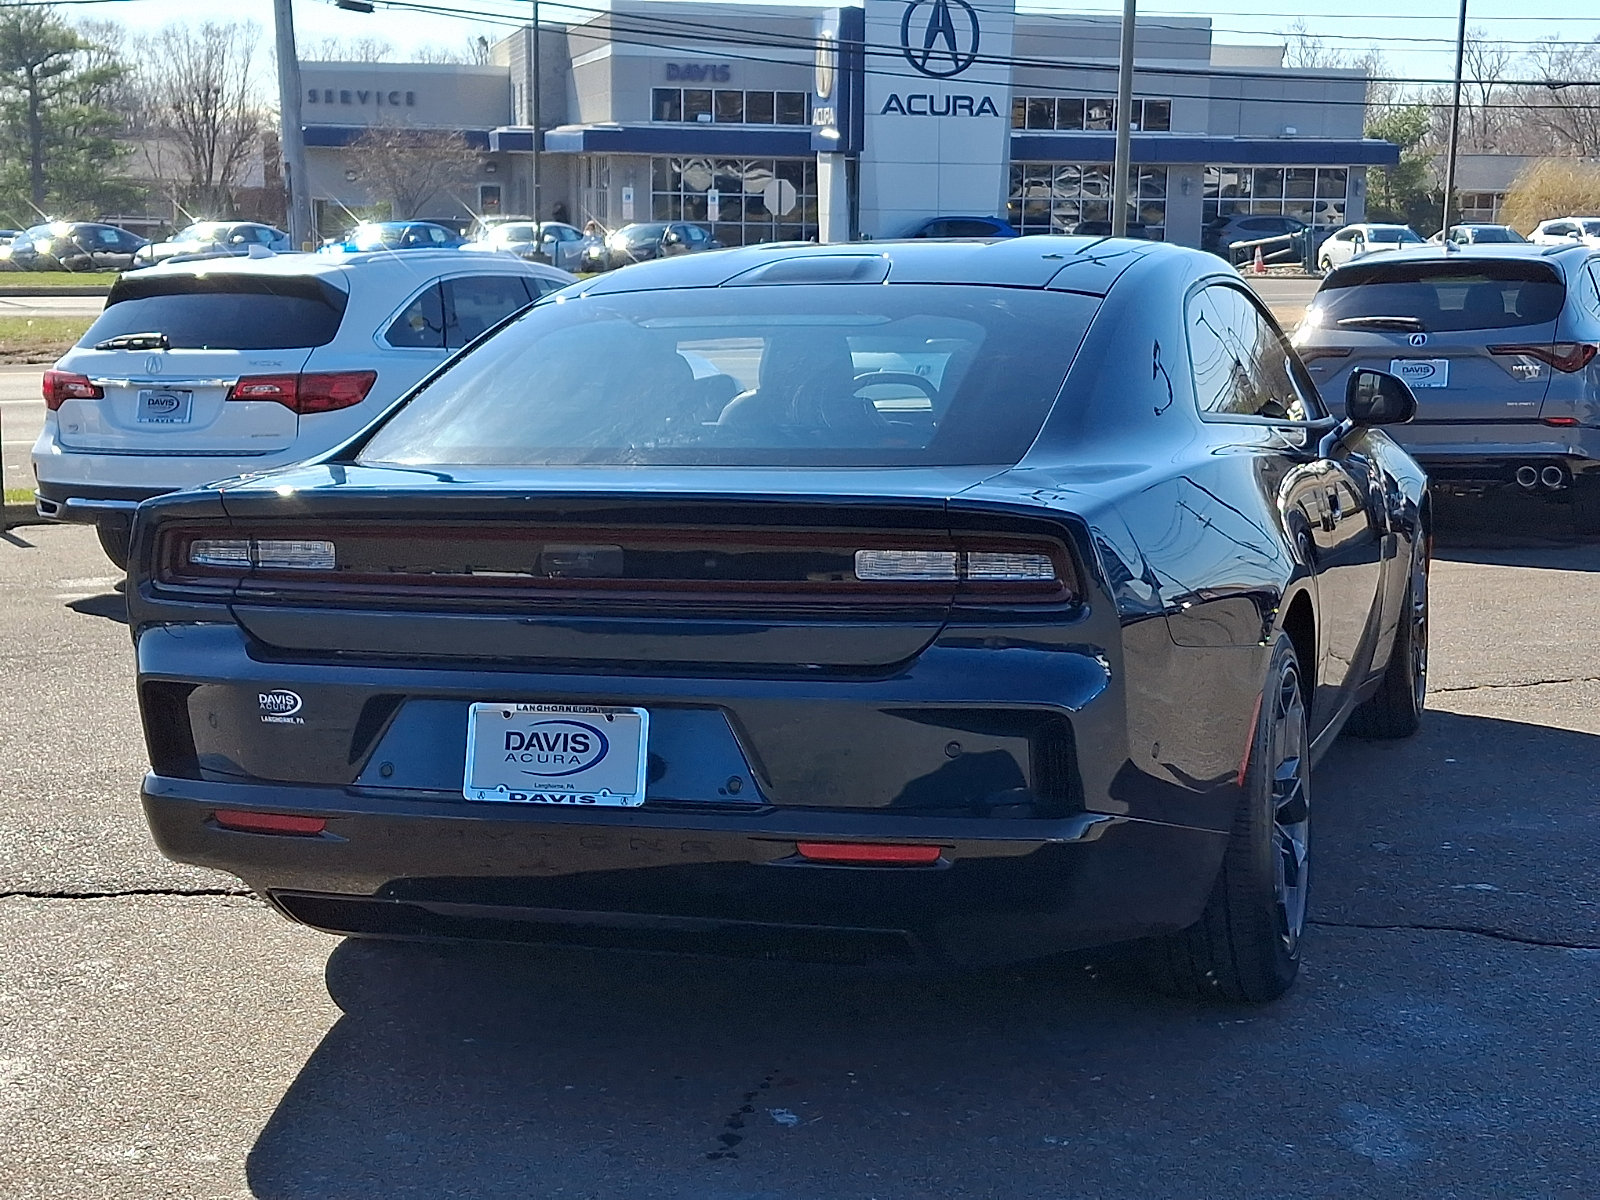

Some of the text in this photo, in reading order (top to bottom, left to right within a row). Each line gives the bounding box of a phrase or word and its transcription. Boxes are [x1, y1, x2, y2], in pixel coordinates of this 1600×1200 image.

[666, 63, 730, 81] DAVIS
[307, 88, 416, 106] SERVICE
[881, 93, 999, 117] ACURA
[812, 107, 834, 126] ACURA
[147, 398, 175, 406] DAVIS
[258, 693, 294, 705] DAVIS
[259, 703, 292, 711] ACURA
[504, 731, 591, 754] DAVIS
[504, 753, 582, 765] ACURA
[508, 792, 597, 804] DAVIS
